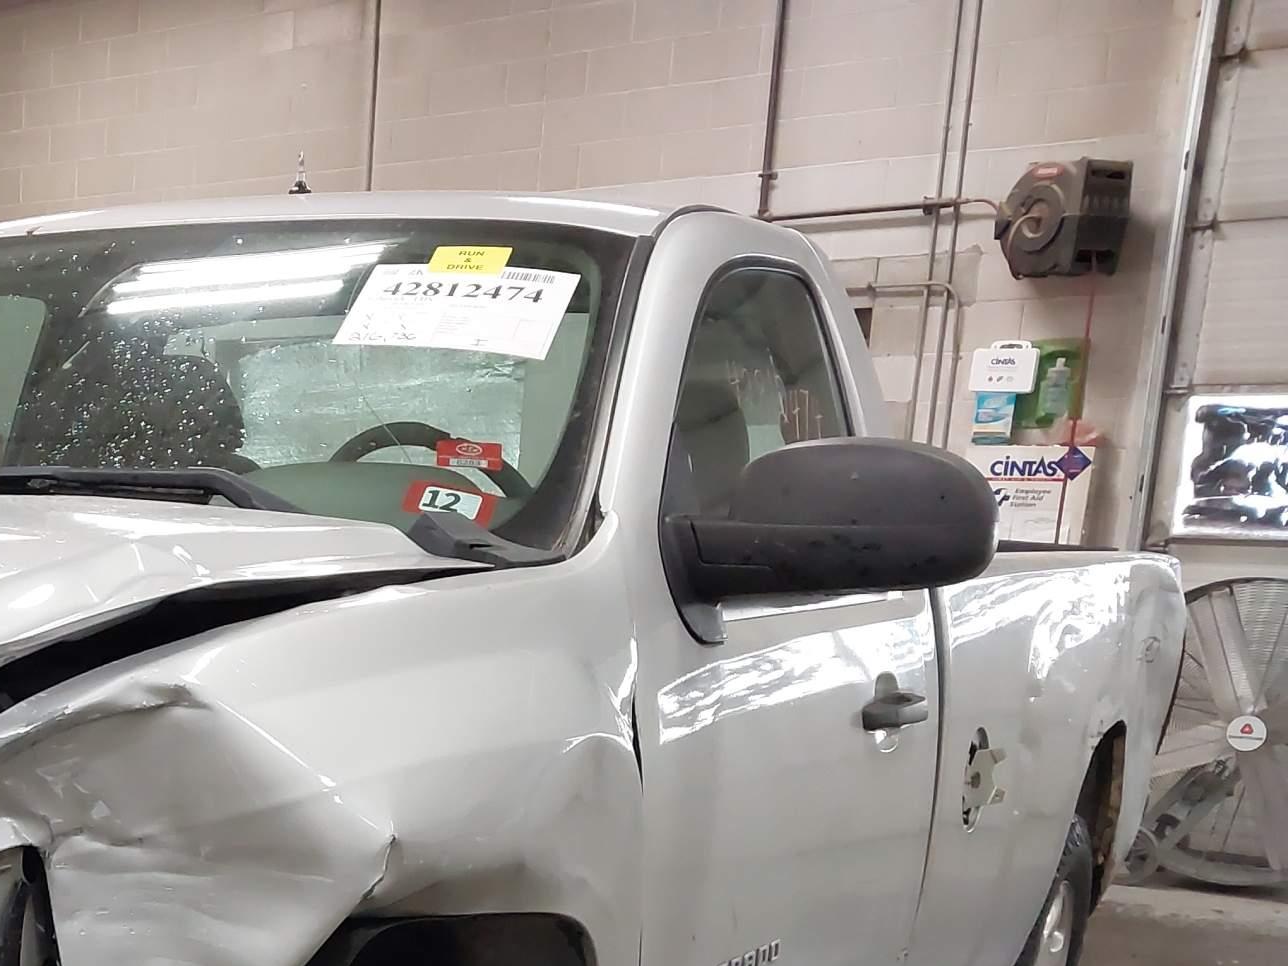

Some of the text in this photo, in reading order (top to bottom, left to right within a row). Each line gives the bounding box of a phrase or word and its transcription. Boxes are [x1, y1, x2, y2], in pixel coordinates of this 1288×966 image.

[383, 281, 544, 304] 42812474
[990, 456, 1058, 477] CINTAS
[421, 489, 462, 512] 12
[1014, 488, 1051, 496] Employee
